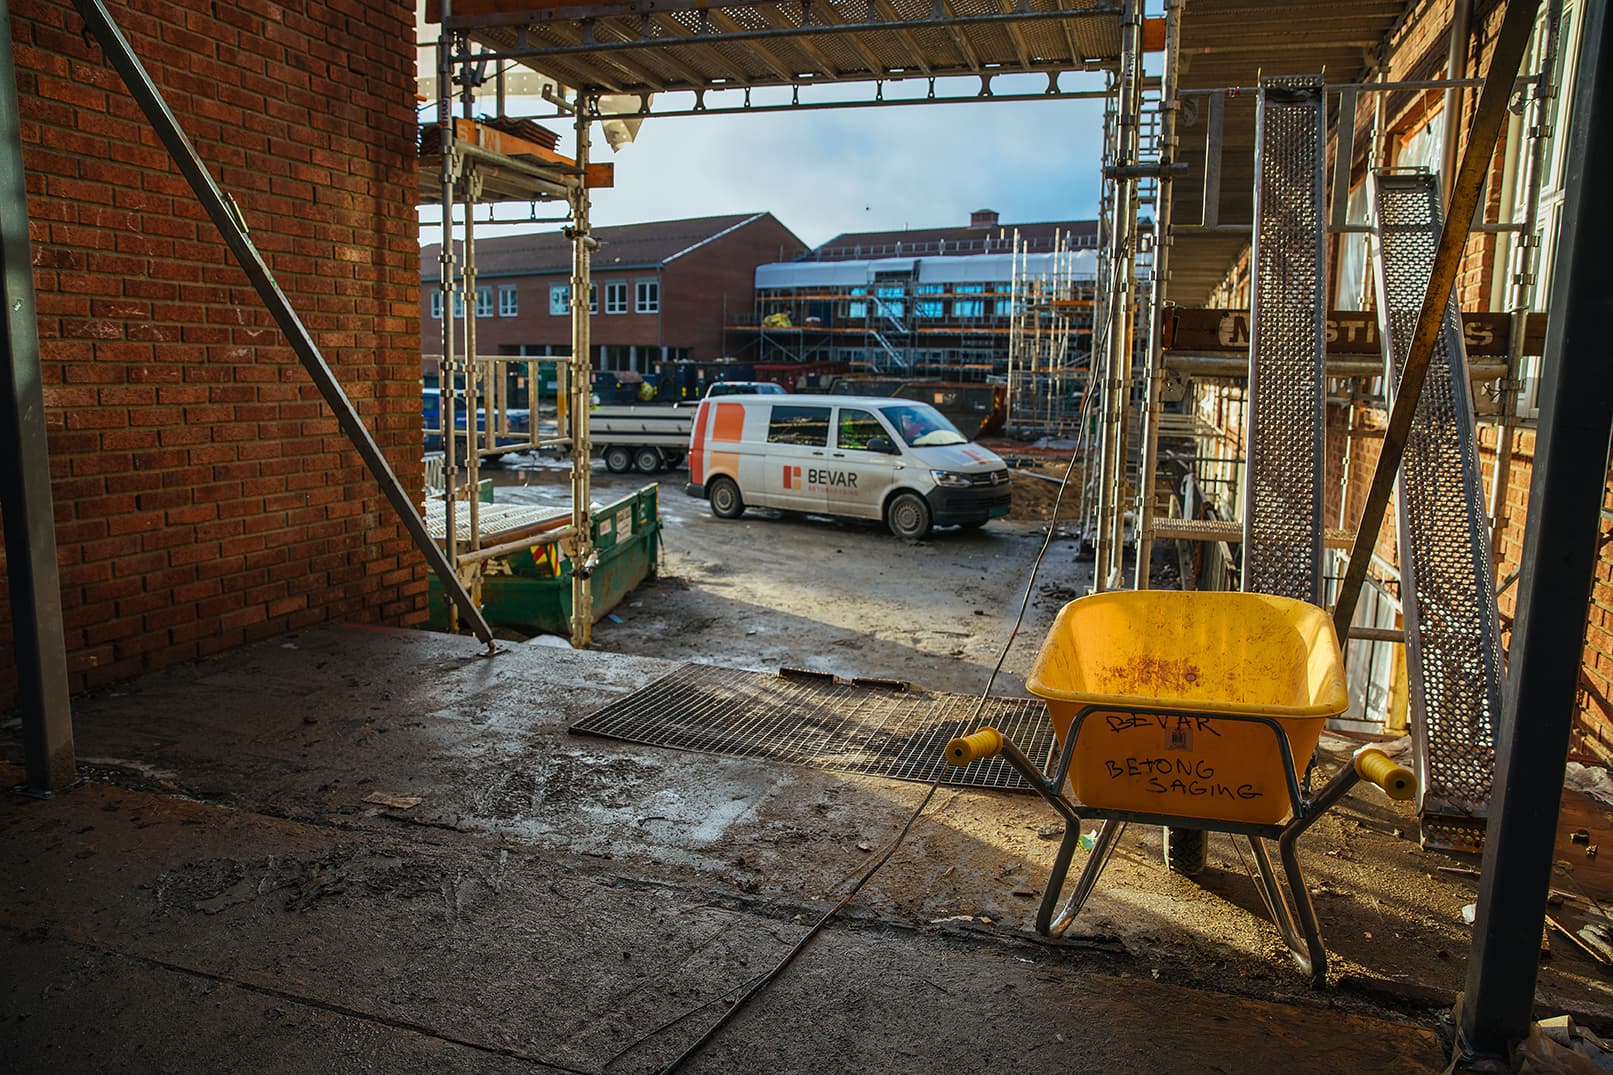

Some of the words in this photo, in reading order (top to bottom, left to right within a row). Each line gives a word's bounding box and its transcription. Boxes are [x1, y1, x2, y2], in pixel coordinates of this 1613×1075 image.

[808, 468, 858, 488] BEVAR
[1105, 713, 1222, 737] BEVAR
[1105, 758, 1215, 780] BETONG
